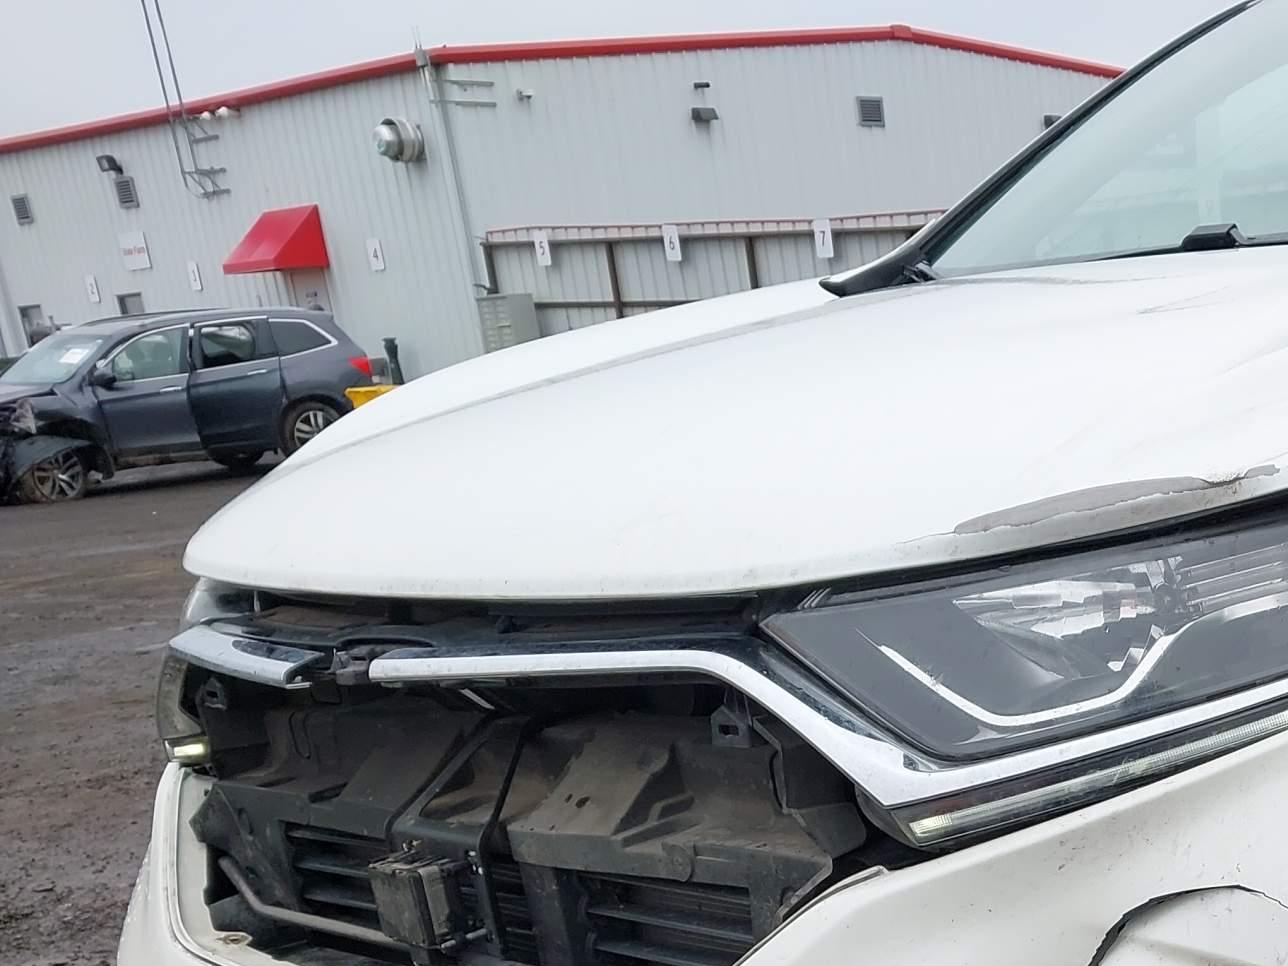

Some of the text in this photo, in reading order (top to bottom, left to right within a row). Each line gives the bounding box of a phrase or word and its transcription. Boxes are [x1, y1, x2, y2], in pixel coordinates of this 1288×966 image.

[668, 235, 676, 251] 6
[819, 230, 826, 247] 7
[372, 247, 379, 262] 4
[538, 240, 547, 256] 5
